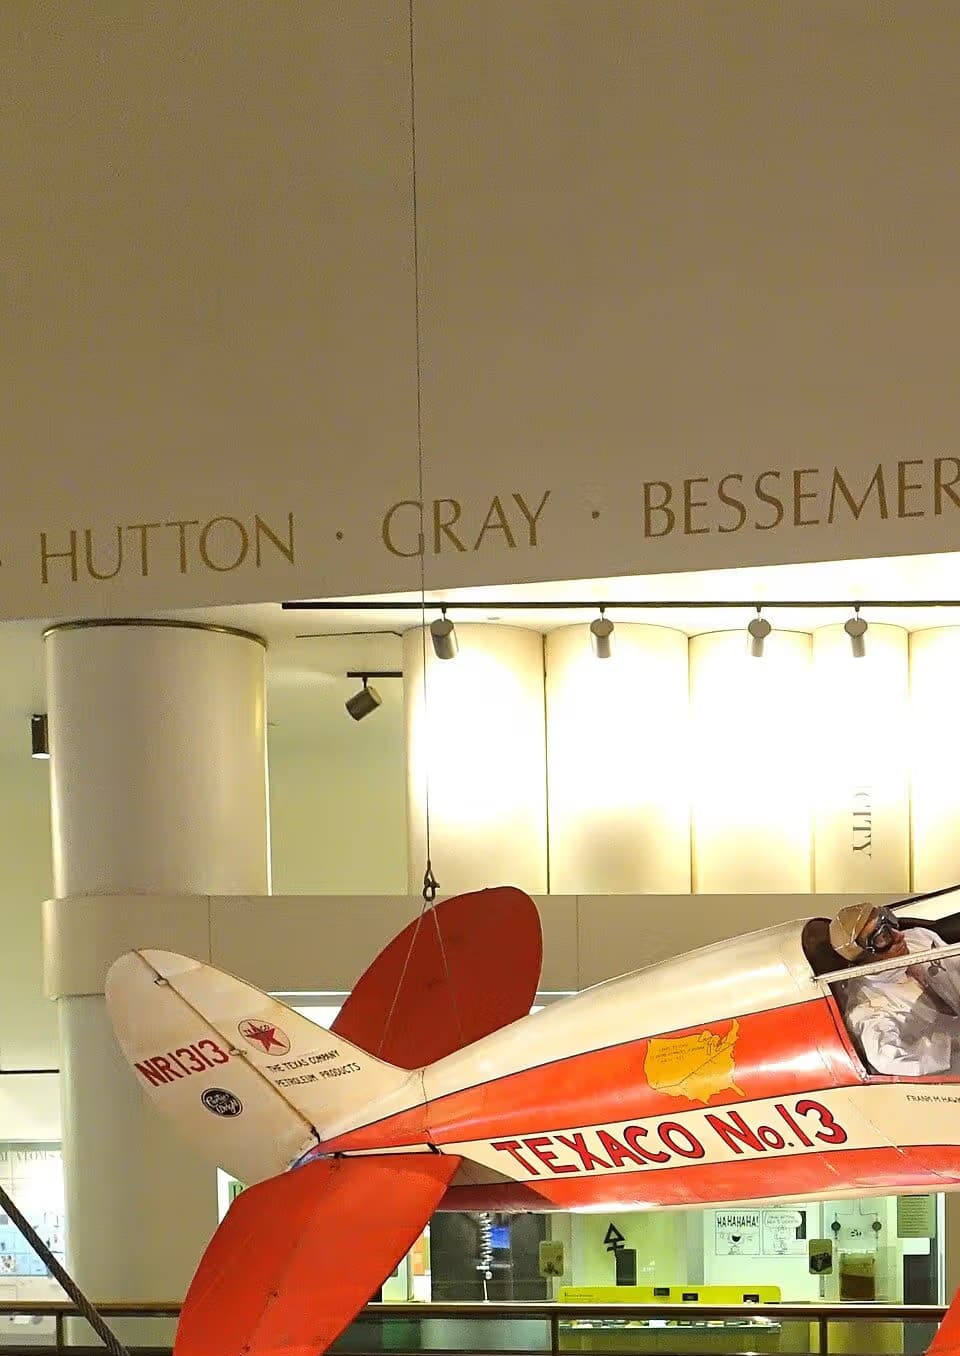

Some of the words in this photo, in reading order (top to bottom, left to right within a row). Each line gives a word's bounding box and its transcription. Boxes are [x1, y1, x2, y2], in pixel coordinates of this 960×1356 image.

[40, 512, 296, 585] HUTTON
[381, 489, 551, 559] GRAY
[134, 1039, 230, 1087] NR1313
[275, 1073, 319, 1088] PETROLEUM
[319, 1062, 361, 1079] PRODUCTS
[282, 1059, 309, 1070] TEXAS
[308, 1049, 340, 1064] COMPANY
[495, 1121, 705, 1177] TEXACO
